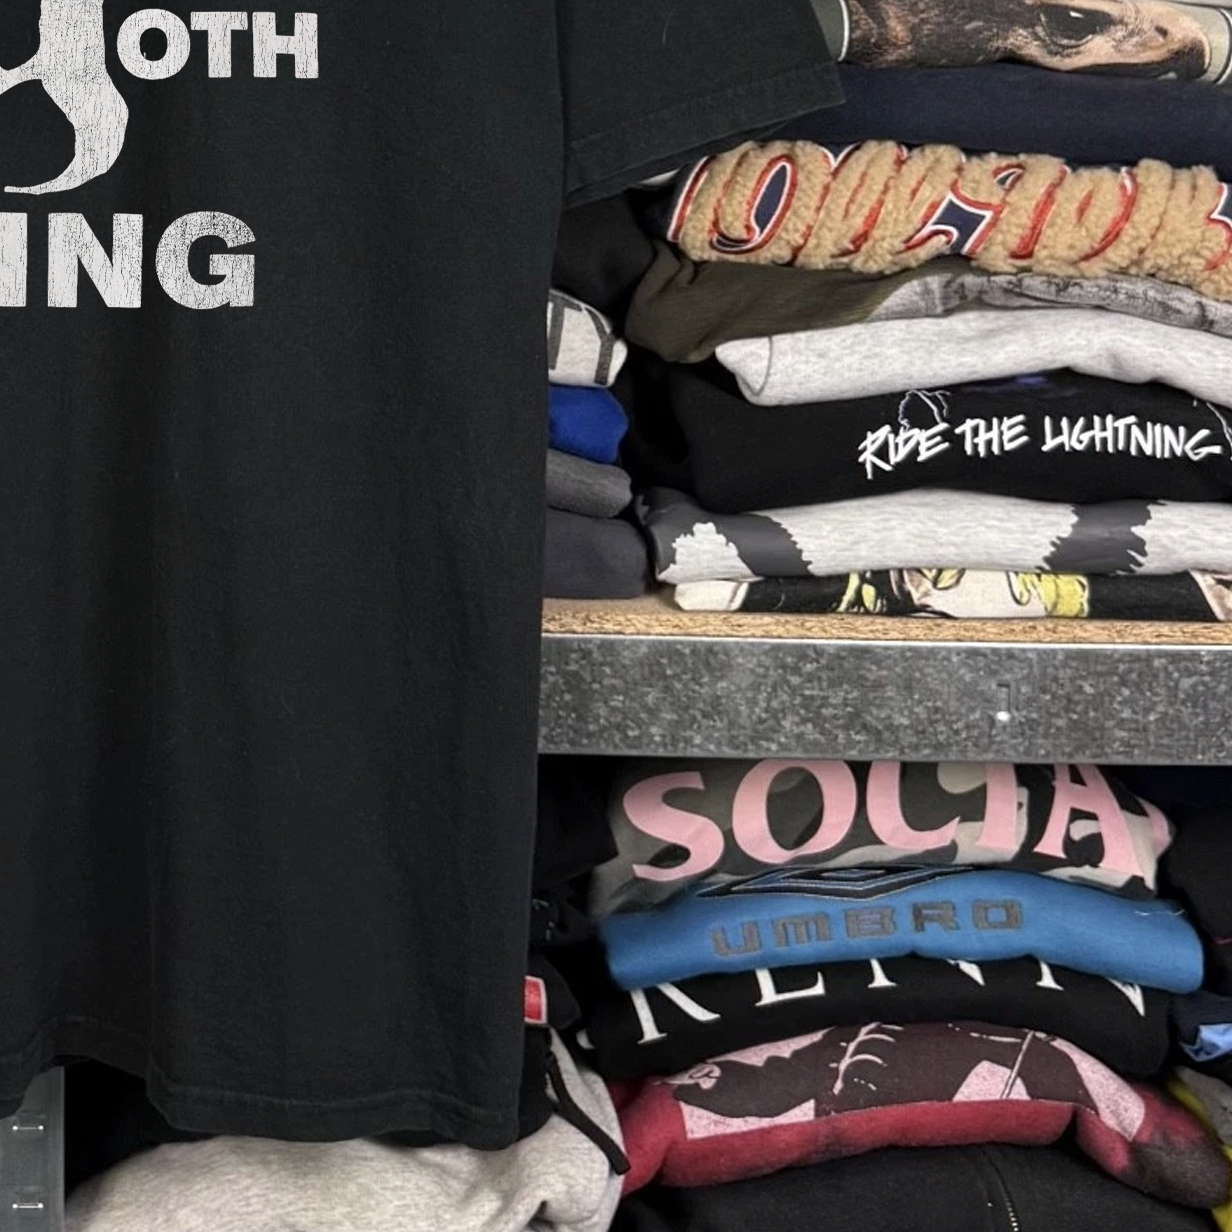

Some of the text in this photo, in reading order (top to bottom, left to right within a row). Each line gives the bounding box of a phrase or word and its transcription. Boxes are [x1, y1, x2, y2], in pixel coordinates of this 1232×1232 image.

[857, 413, 1223, 480] RIDE THE LIGHTNING
[709, 899, 1025, 957] UMBRO
